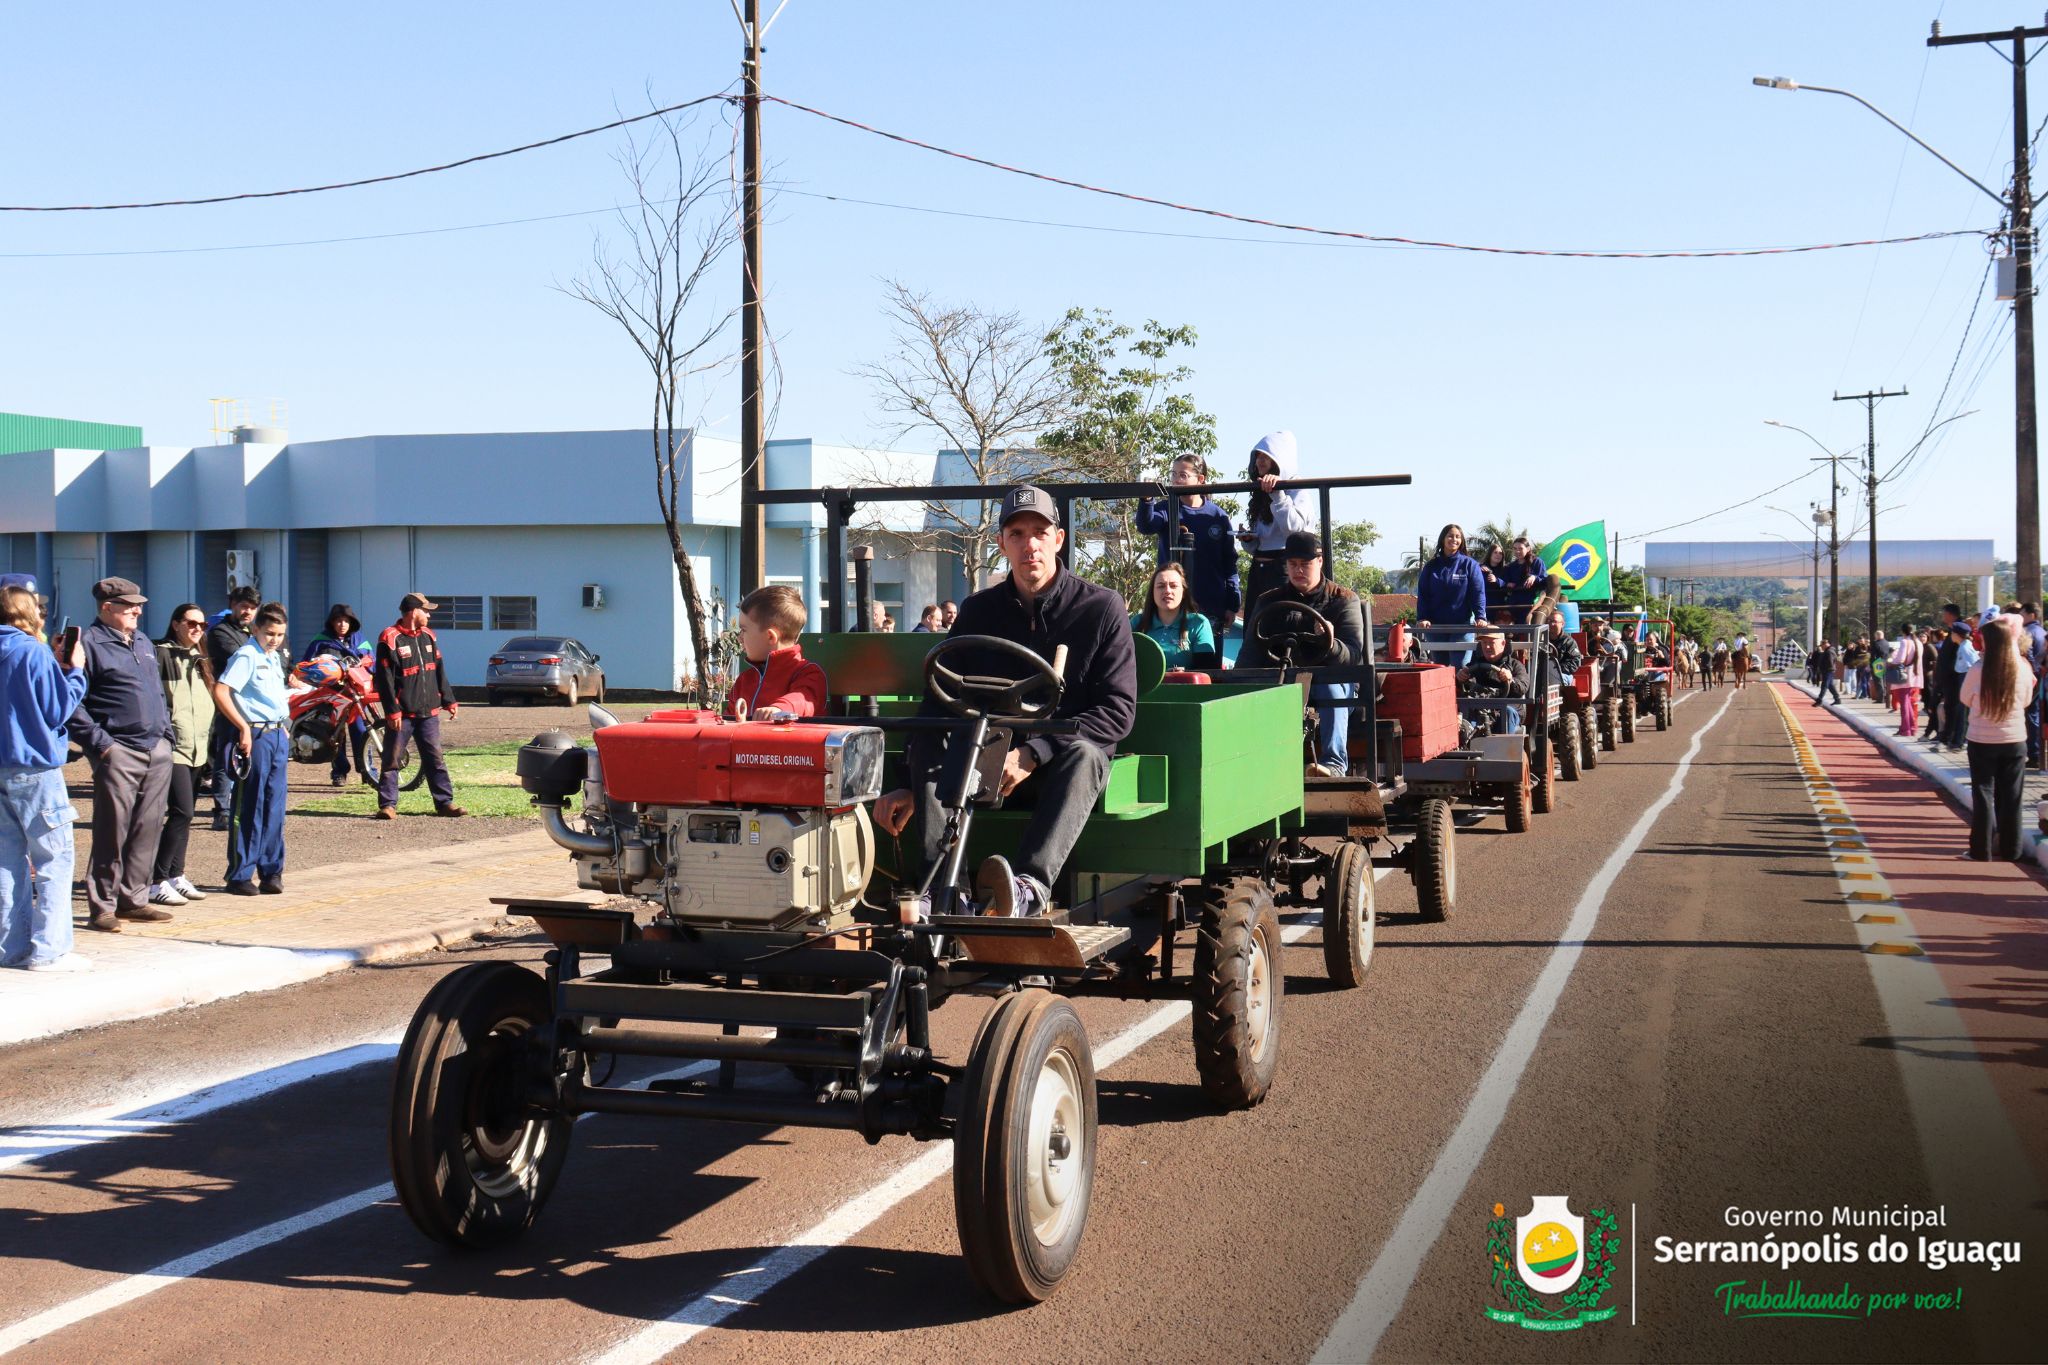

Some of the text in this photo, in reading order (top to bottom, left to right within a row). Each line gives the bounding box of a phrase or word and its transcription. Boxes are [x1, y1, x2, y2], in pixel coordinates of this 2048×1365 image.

[735, 753, 814, 766] MOTOR DIESEL ORIGINAL
